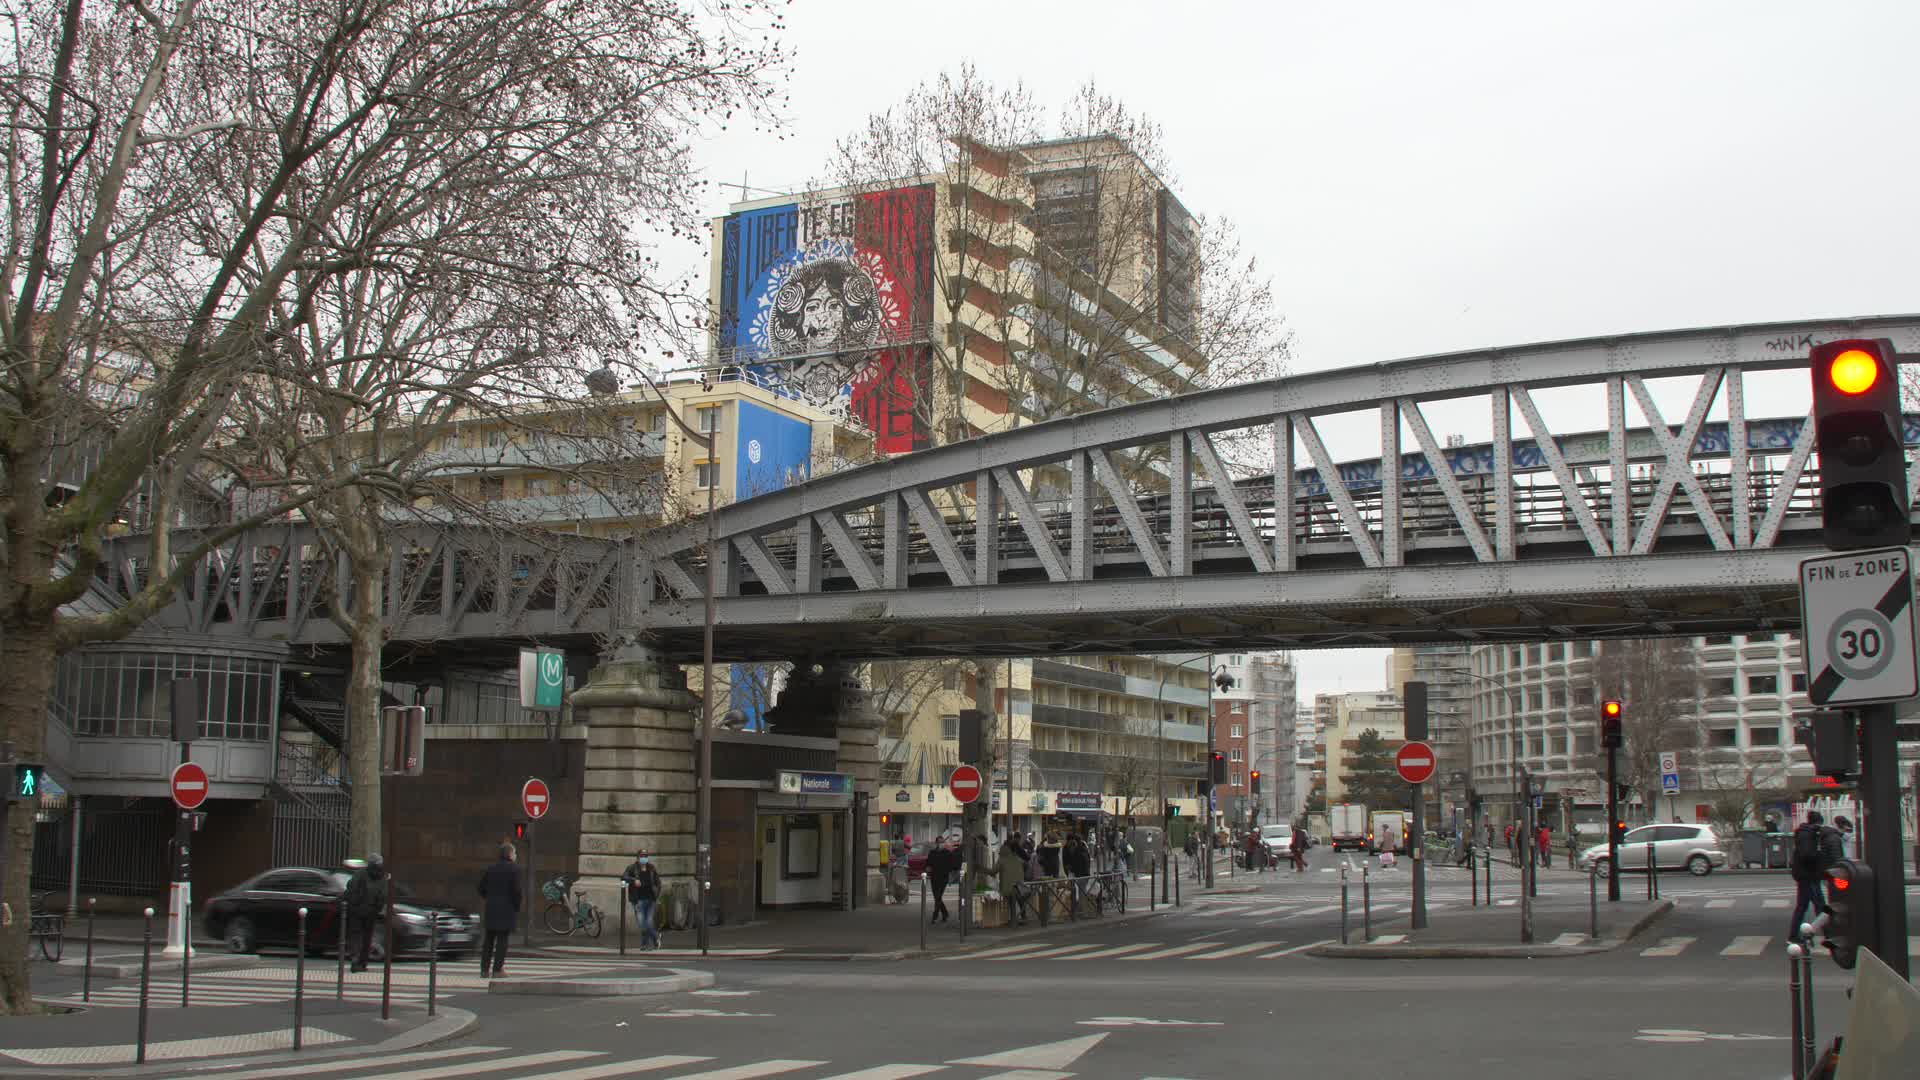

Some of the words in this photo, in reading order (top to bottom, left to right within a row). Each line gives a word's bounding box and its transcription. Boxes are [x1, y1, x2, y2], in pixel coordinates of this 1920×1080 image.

[1808, 565, 1835, 583] FIN
[1838, 570, 1850, 578] DE
[1854, 557, 1901, 577] ZONE
[1839, 627, 1881, 660] 30
[546, 659, 560, 678] M
